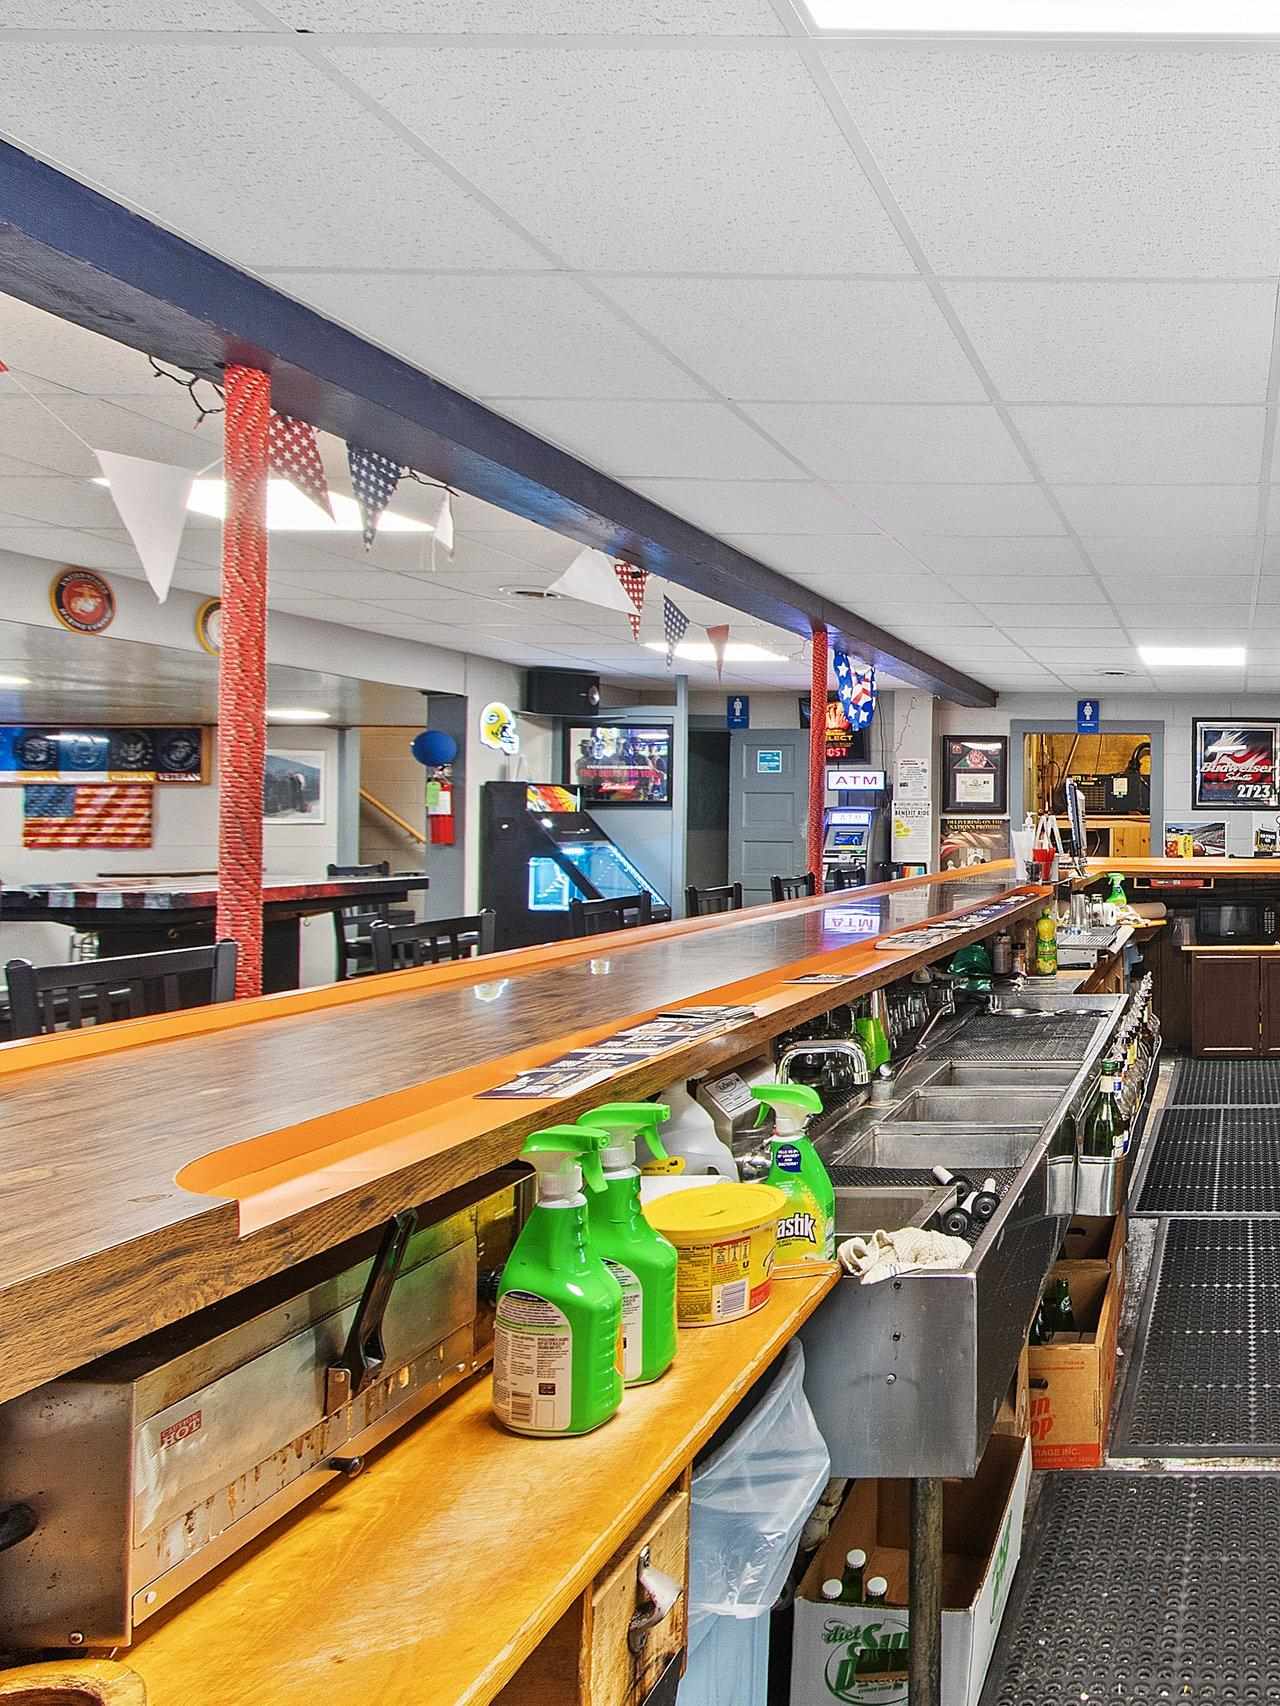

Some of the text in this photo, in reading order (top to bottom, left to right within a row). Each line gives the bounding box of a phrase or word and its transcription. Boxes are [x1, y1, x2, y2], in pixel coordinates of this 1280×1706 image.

[1200, 761, 1274, 774] Budweiser
[835, 775, 878, 786] ATM
[1237, 784, 1271, 798] 2723
[776, 1213, 816, 1241] astik
[160, 1419, 201, 1450] HOT
[825, 1623, 862, 1643] diet
